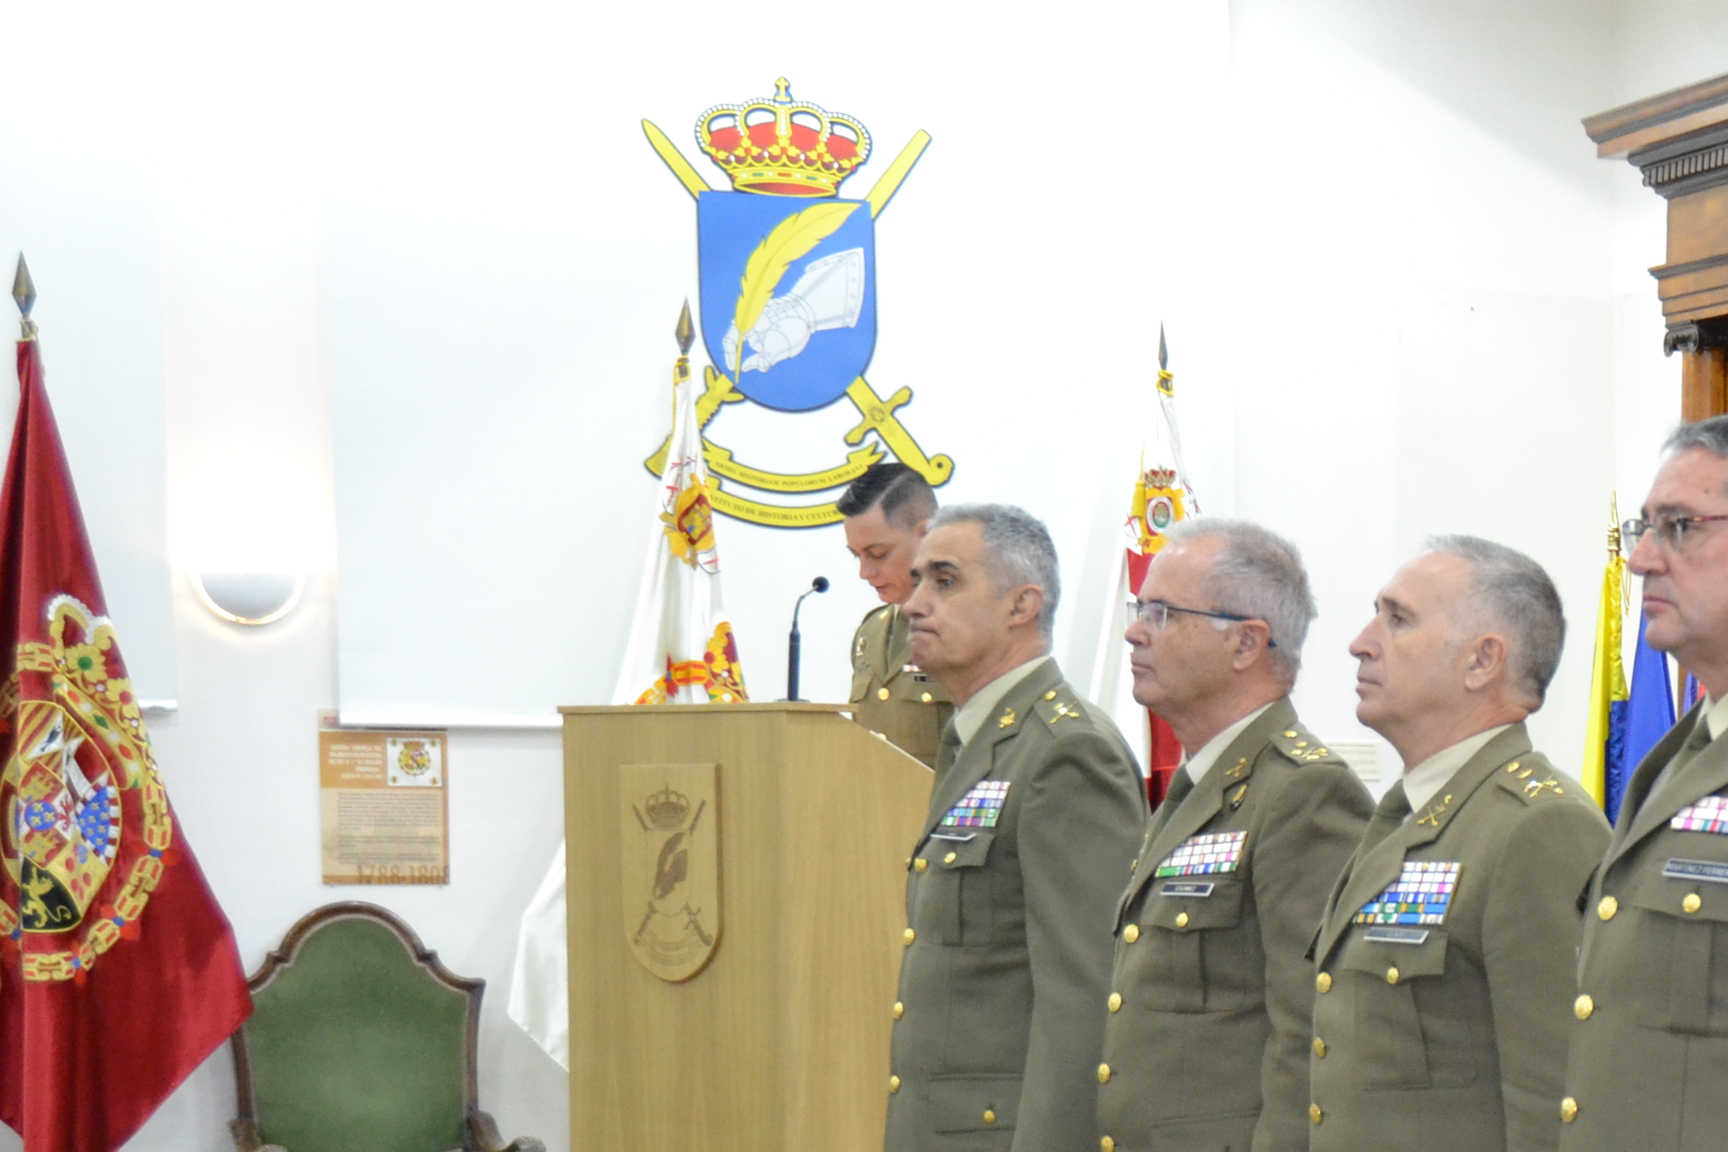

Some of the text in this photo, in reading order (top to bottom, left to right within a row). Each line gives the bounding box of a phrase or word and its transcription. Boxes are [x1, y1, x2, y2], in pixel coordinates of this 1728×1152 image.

[739, 471, 780, 486] HISTORIAM
[781, 476, 826, 486] POPULORUM
[757, 510, 798, 521] HISTORIA
[805, 509, 840, 520] CULTUR
